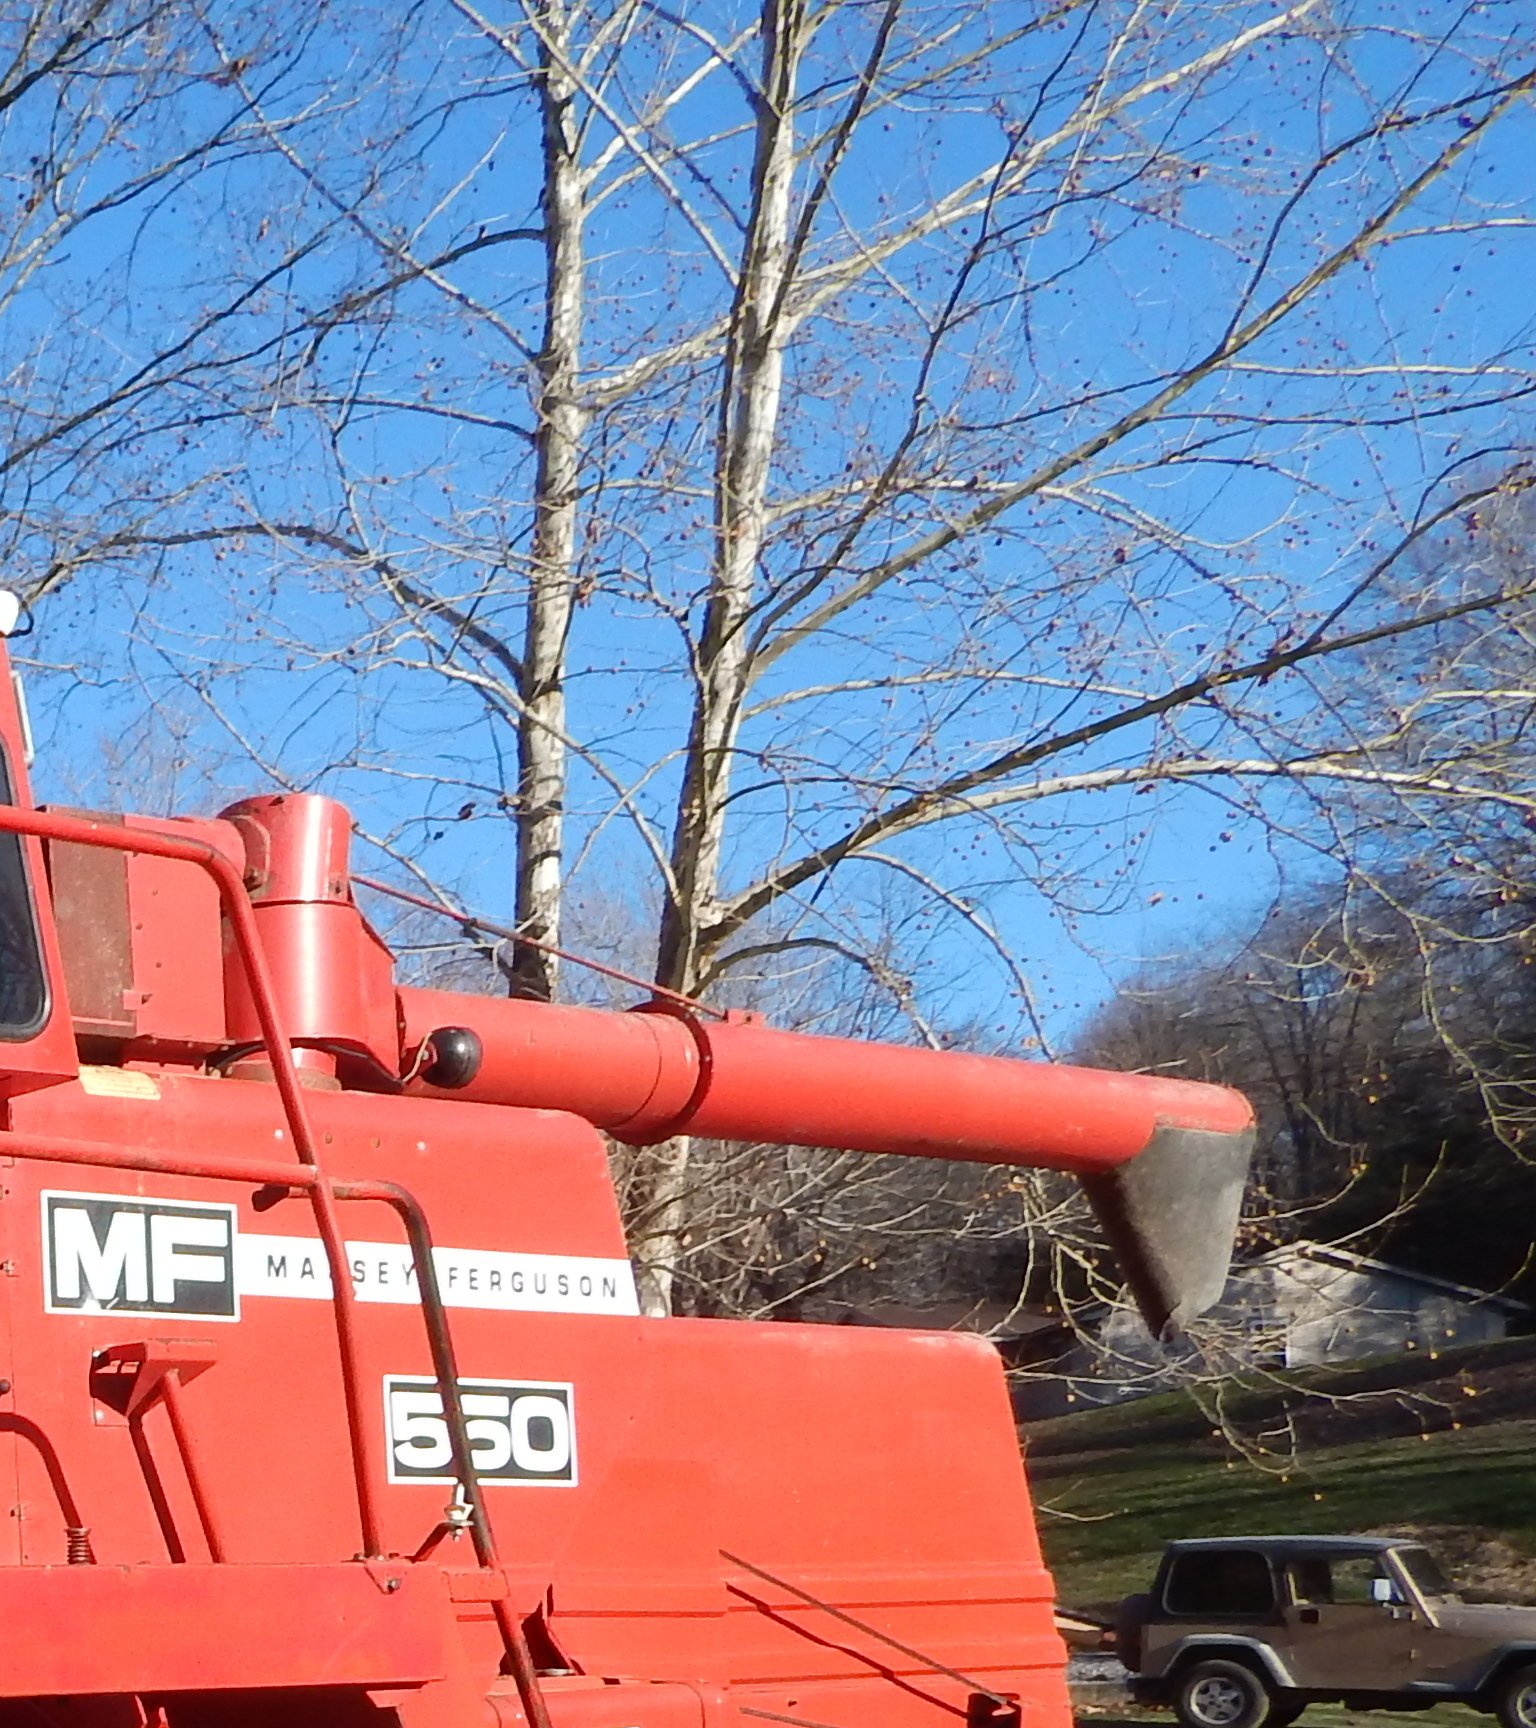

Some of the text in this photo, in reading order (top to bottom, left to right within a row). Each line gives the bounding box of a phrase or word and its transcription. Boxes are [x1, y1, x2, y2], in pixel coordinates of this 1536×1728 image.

[54, 1207, 228, 1303] MF
[267, 1255, 617, 1298] MASEY FERGUSON
[390, 1391, 570, 1472] 550
